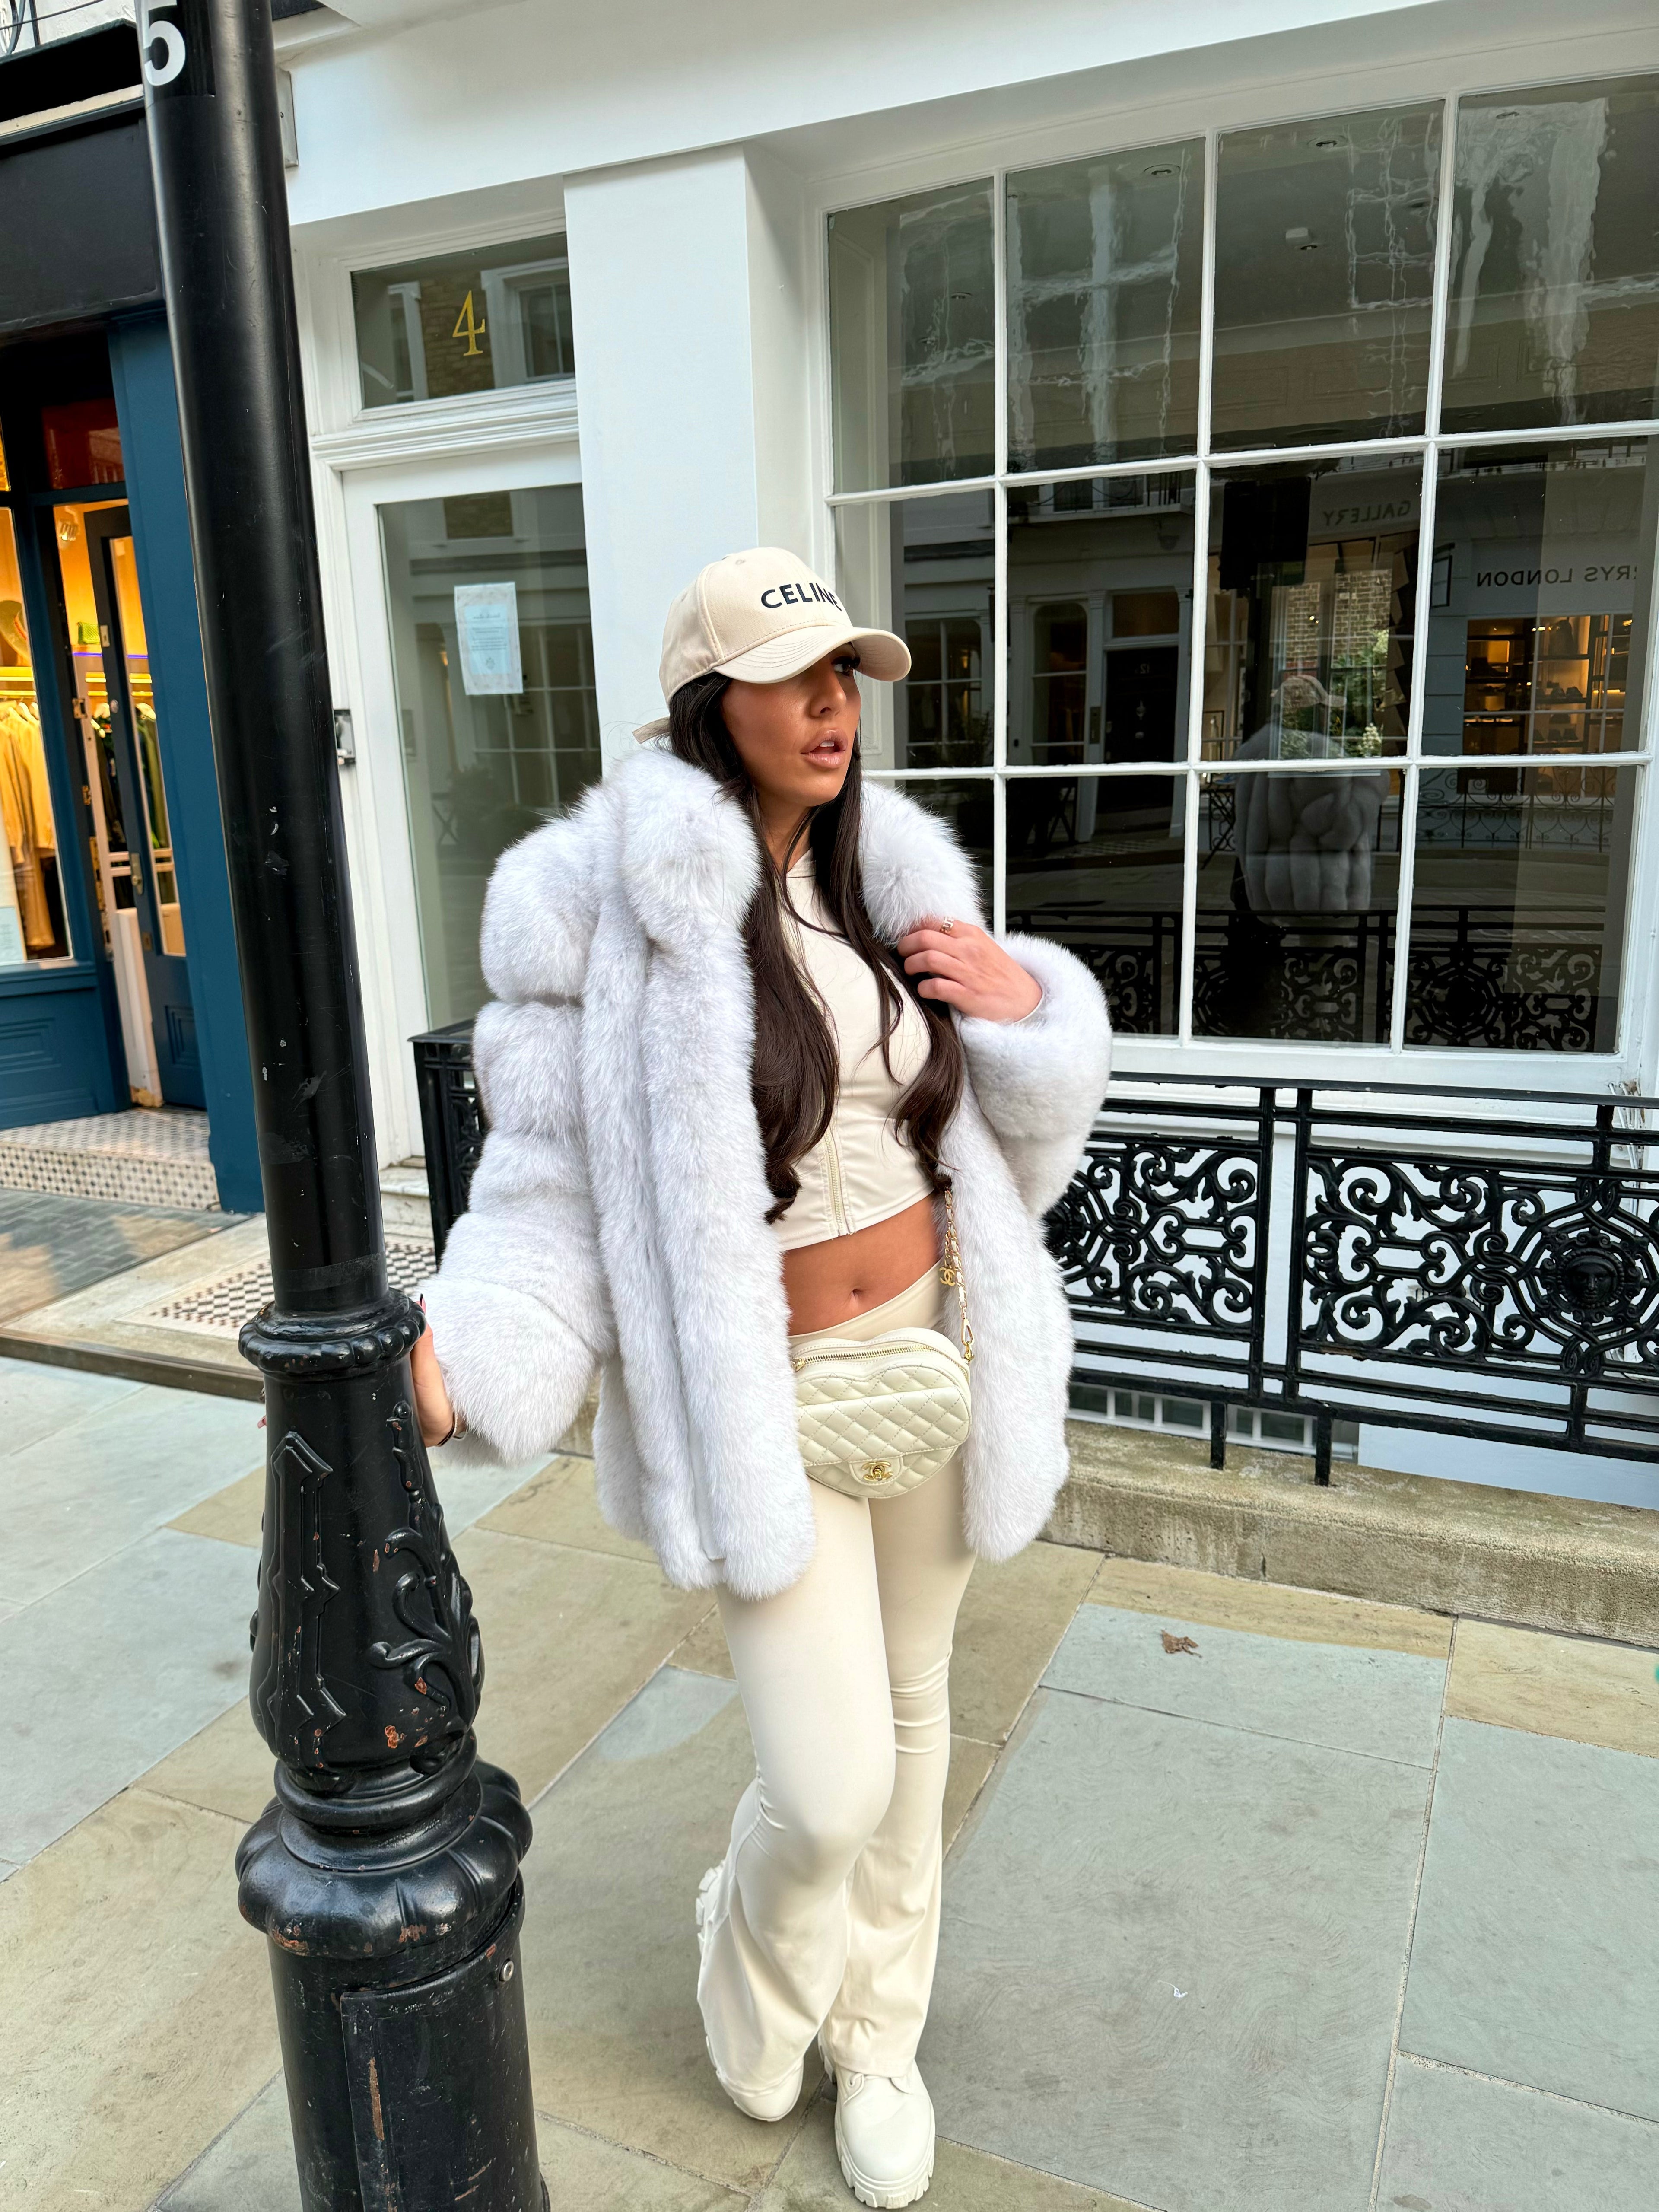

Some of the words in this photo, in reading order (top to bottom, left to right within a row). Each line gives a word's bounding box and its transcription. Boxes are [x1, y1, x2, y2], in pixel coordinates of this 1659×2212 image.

[141, 0, 185, 86] 5
[452, 290, 485, 356] 4
[761, 582, 842, 612] CELINE
